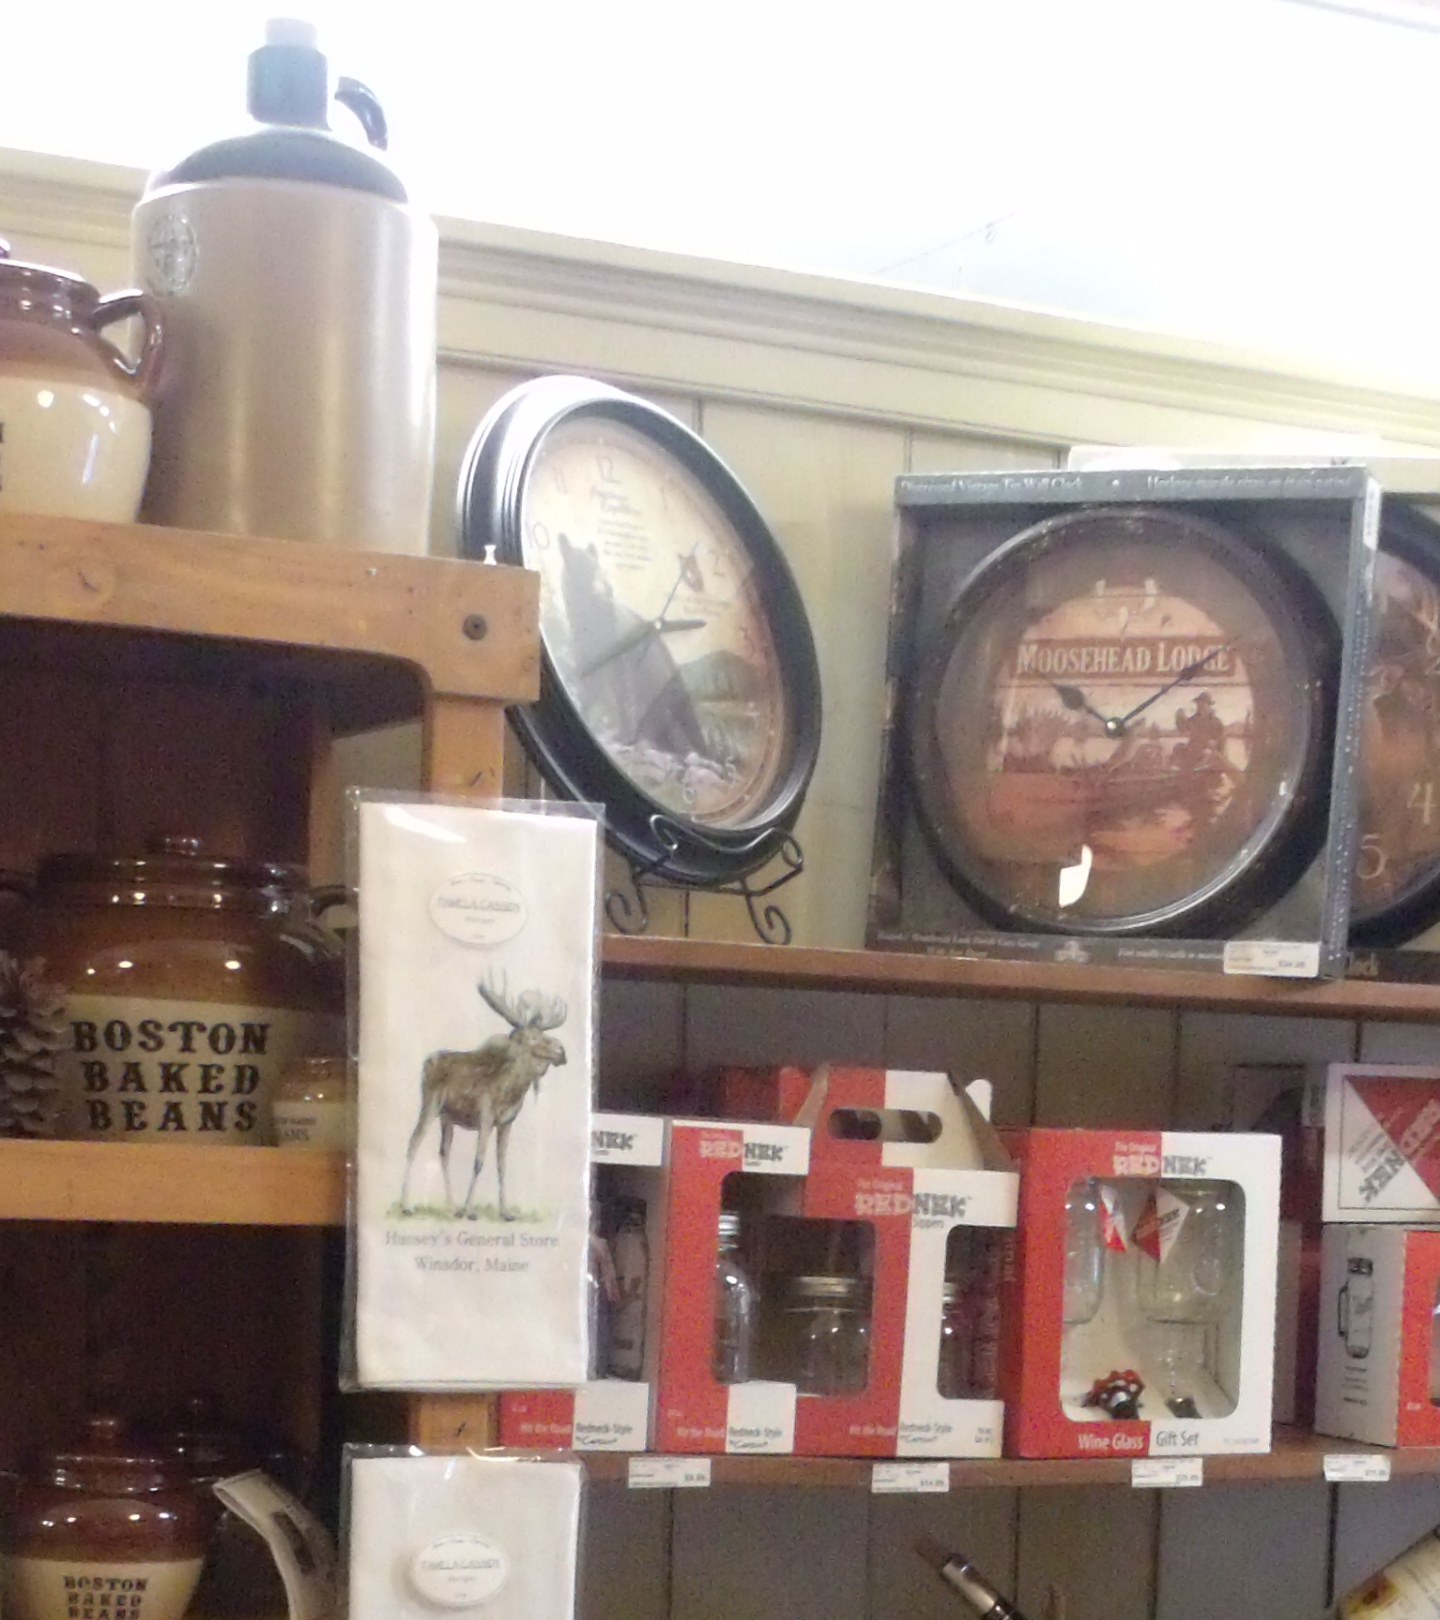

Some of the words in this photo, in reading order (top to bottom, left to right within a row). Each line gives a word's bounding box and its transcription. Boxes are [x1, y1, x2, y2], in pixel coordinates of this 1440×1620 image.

[1016, 643, 1152, 675] MOOSEHEAD
[1158, 642, 1231, 672] LODGE
[1407, 783, 1436, 824] 4
[71, 1020, 272, 1056] BOSTON
[80, 1060, 261, 1096] BAKED
[85, 1099, 259, 1134] BEANS
[385, 1230, 452, 1250] Hussey's
[456, 1230, 517, 1248] General
[520, 1232, 560, 1248] Store
[484, 1256, 530, 1273] Maine
[1078, 1433, 1111, 1450] Wine
[1112, 1433, 1145, 1451] Glass
[1155, 1431, 1177, 1448] Gift
[1179, 1431, 1200, 1447] Set
[63, 1575, 149, 1593] BOSTON
[68, 1592, 143, 1609] BAKED
